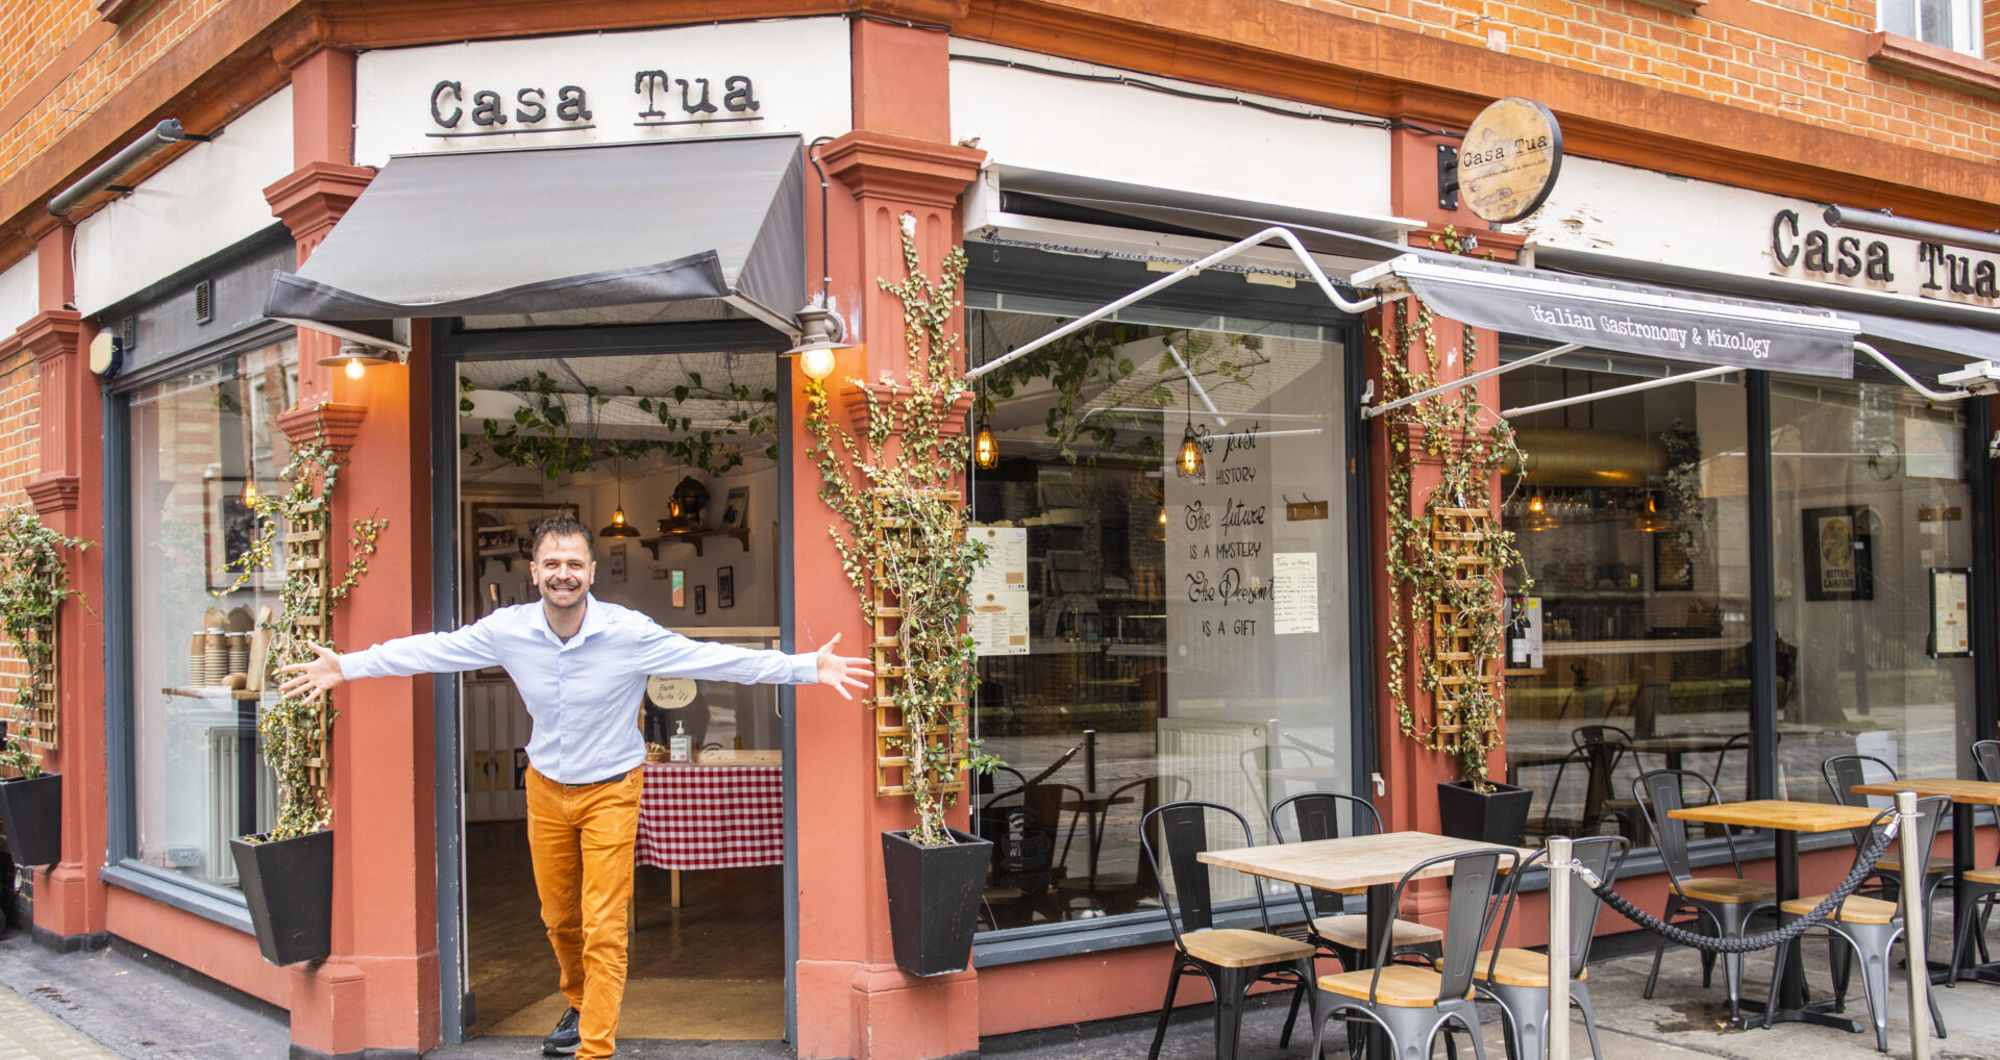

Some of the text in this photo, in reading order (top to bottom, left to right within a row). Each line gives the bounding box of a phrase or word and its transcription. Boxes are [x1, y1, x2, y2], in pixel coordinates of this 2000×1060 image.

[430, 70, 760, 129] Casa Tua
[1463, 136, 1547, 167] Casa Tua
[1772, 209, 2000, 299] Casa Tua
[1528, 304, 1772, 359] Italian Gastronomy & Mixology
[1193, 420, 1261, 463] The past
[1216, 467, 1256, 485] HISTORY
[1185, 497, 1265, 537] The future
[1190, 541, 1261, 560] IS A MYSTERY
[1185, 570, 1215, 603] The
[1218, 567, 1274, 606] Present
[1202, 619, 1256, 637] IS A GIFT
